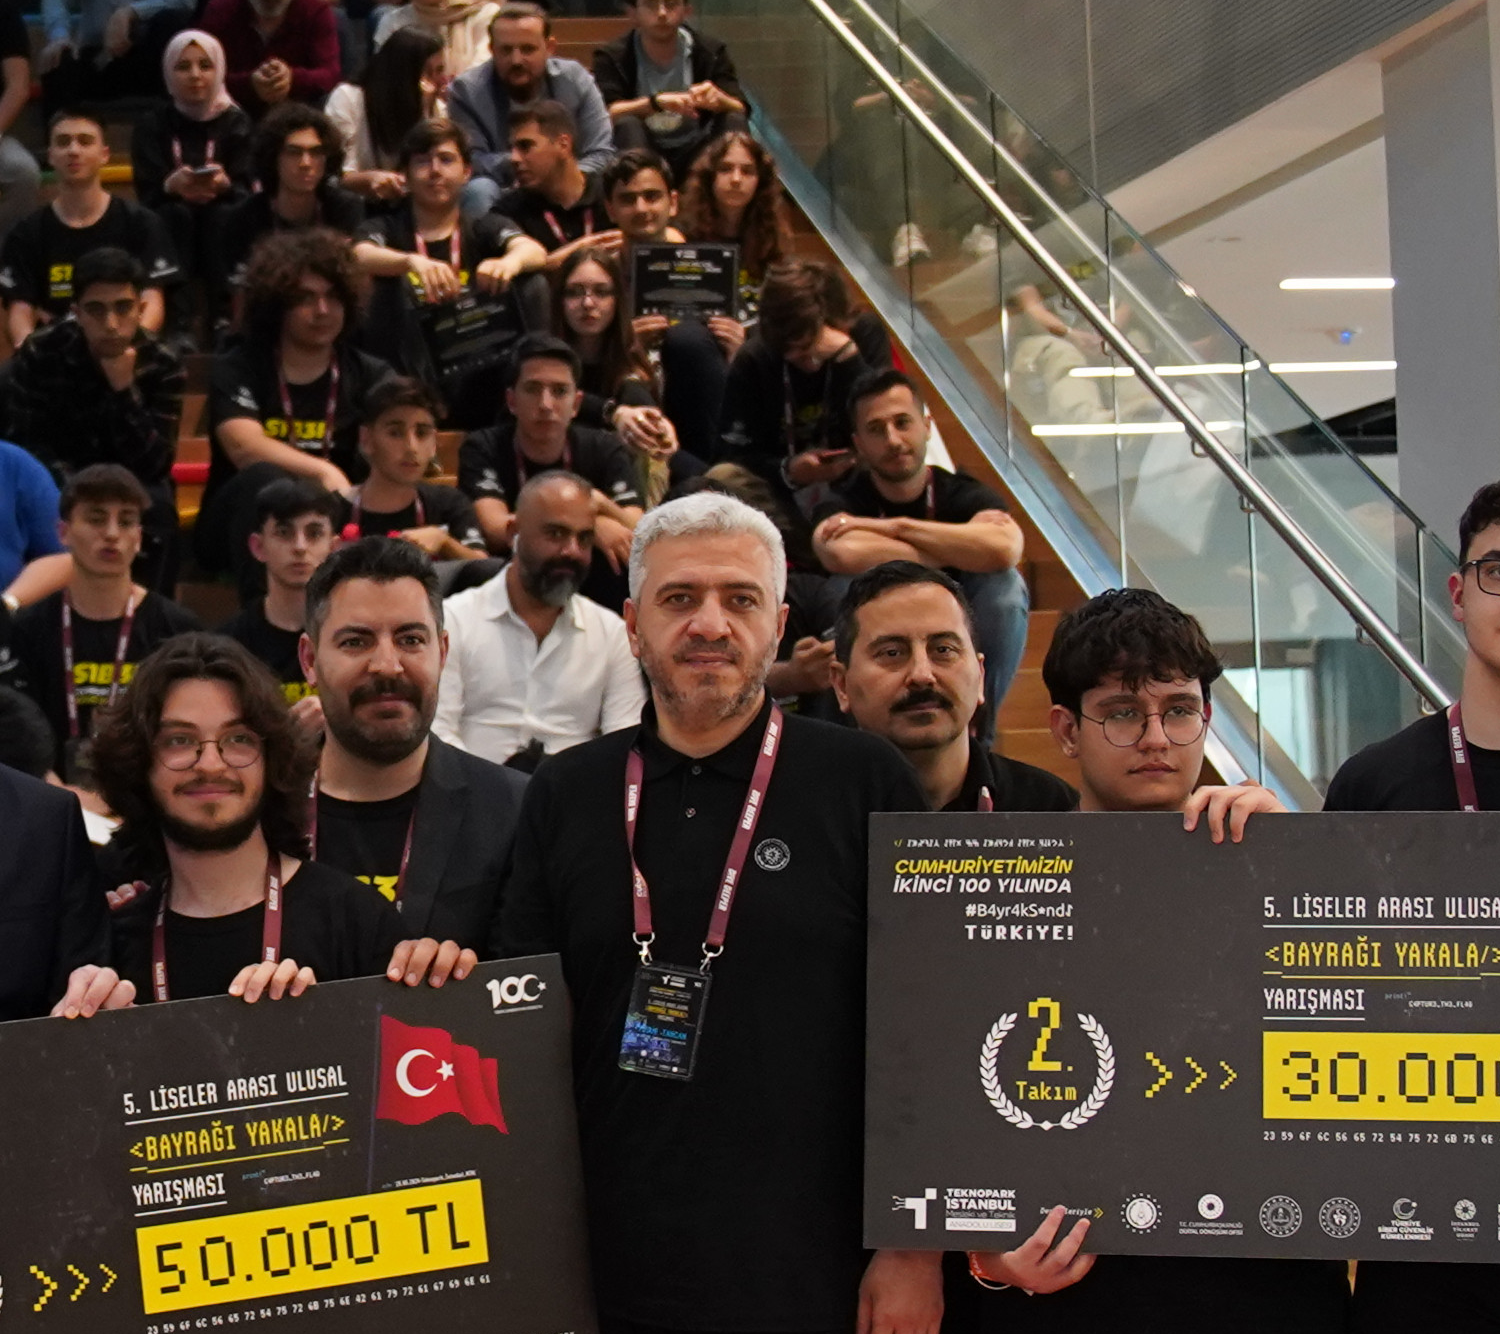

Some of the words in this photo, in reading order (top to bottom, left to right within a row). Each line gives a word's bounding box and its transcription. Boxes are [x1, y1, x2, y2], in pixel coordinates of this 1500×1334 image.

[895, 855, 1073, 874] CUMHURİYETİMİZİN
[893, 874, 953, 893] İKİNCİ
[958, 877, 991, 893] 100
[997, 877, 1072, 893] YILINDA
[1263, 896, 1282, 919] 5.
[1292, 893, 1367, 919] LİSELER
[1377, 896, 1434, 919] ARASI
[1264, 935, 1382, 968] <BAYRAĞI
[1263, 988, 1365, 1015] YARIŞMASI
[1027, 997, 1073, 1072] 2.
[123, 1093, 142, 1115] 5.
[150, 1082, 218, 1112] LİSELER
[226, 1074, 278, 1101] ARASI
[286, 1065, 348, 1093] ULUSAL
[1015, 1080, 1078, 1101] Takım
[129, 1120, 235, 1162] <BAYRAĞI
[246, 1113, 346, 1146] YAKALA/>
[132, 1172, 226, 1207] YARIŞMASI
[944, 1195, 1016, 1211] İSTANBUL
[947, 1188, 1016, 1199] TEKNOPARK
[156, 1214, 380, 1295] 50.000
[406, 1201, 470, 1255] TL
